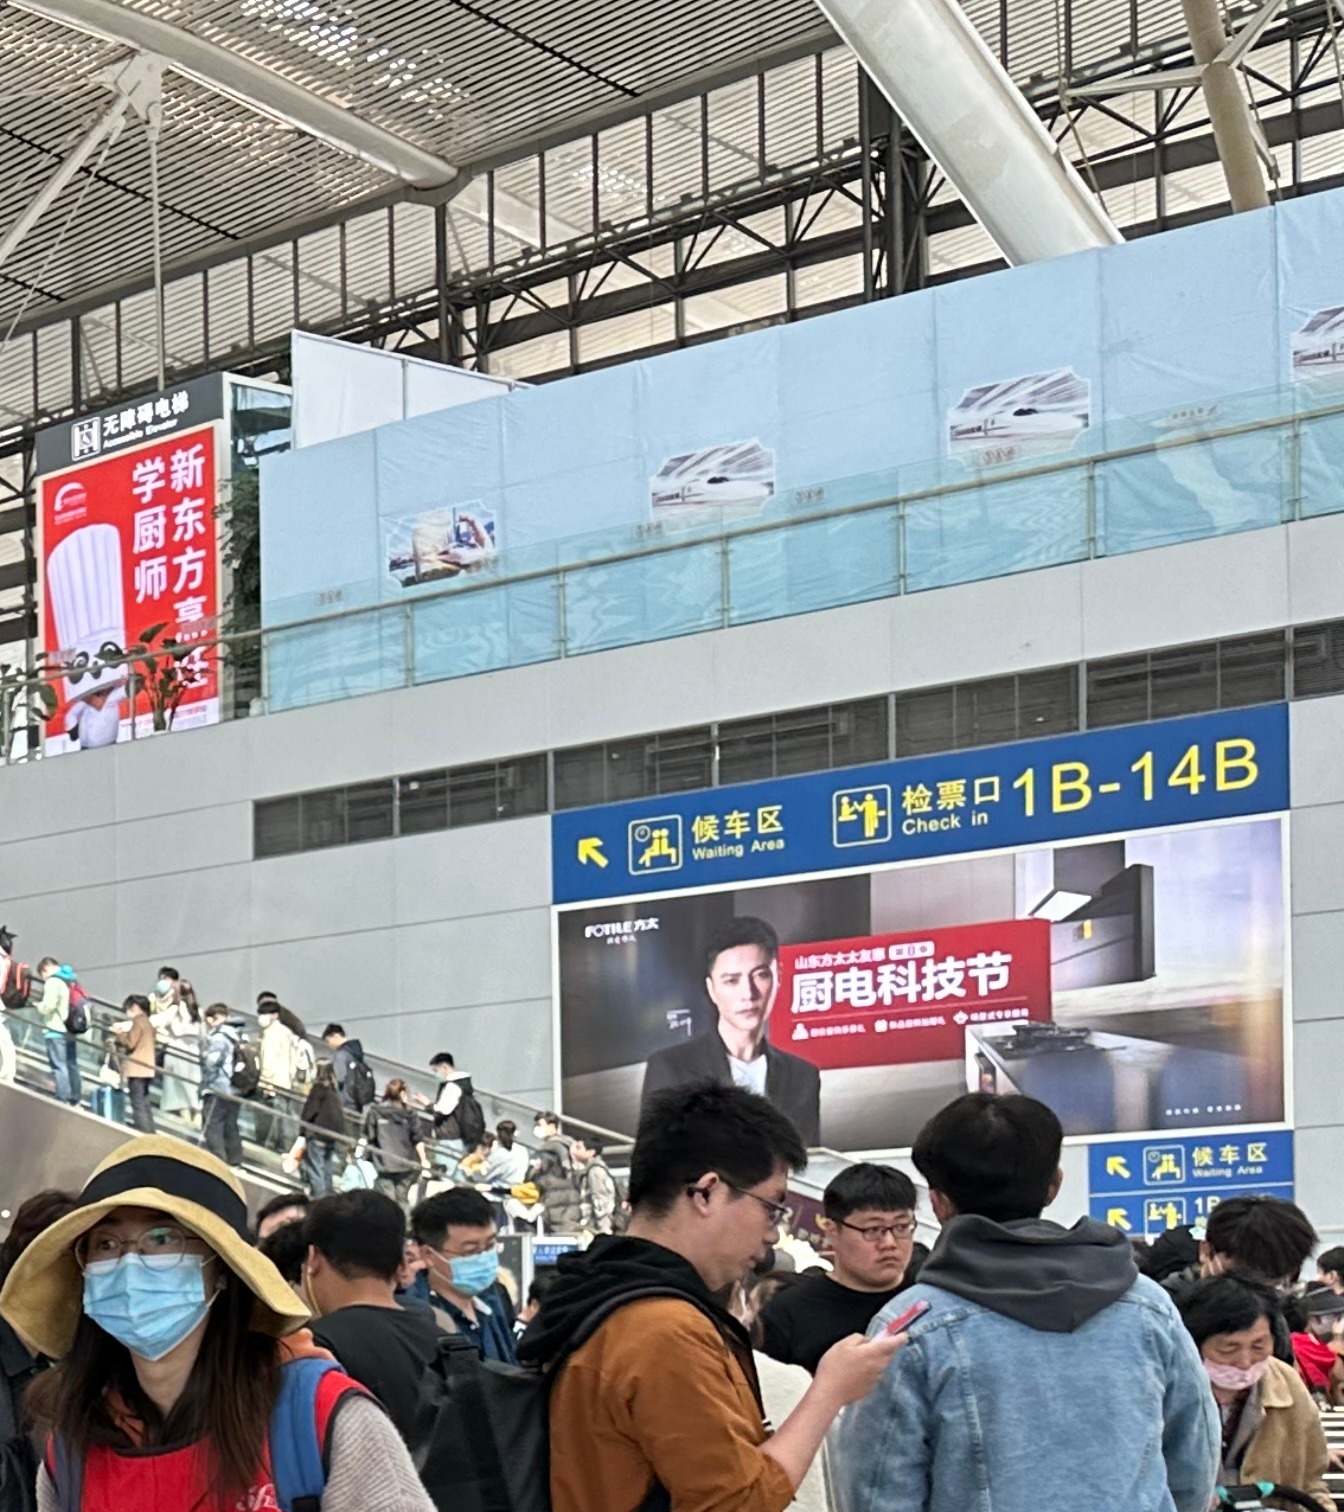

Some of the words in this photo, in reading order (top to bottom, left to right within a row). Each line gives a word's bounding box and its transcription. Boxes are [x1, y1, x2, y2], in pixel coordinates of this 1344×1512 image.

[103, 390, 189, 436] 无障碍电梯
[132, 456, 168, 604] 学厨师
[692, 805, 784, 844] 候车区
[902, 776, 1000, 815] 检票口
[1012, 737, 1258, 816] 1B-14B
[902, 817, 961, 835] Check
[971, 810, 988, 826] in
[692, 842, 744, 861] Waiting
[751, 837, 784, 853] Area
[585, 920, 632, 937] FOTILE
[634, 917, 659, 932] 方太
[791, 951, 1012, 1013] 厨电科技节
[1192, 1142, 1267, 1166] 候车区
[1237, 1164, 1262, 1175] Area
